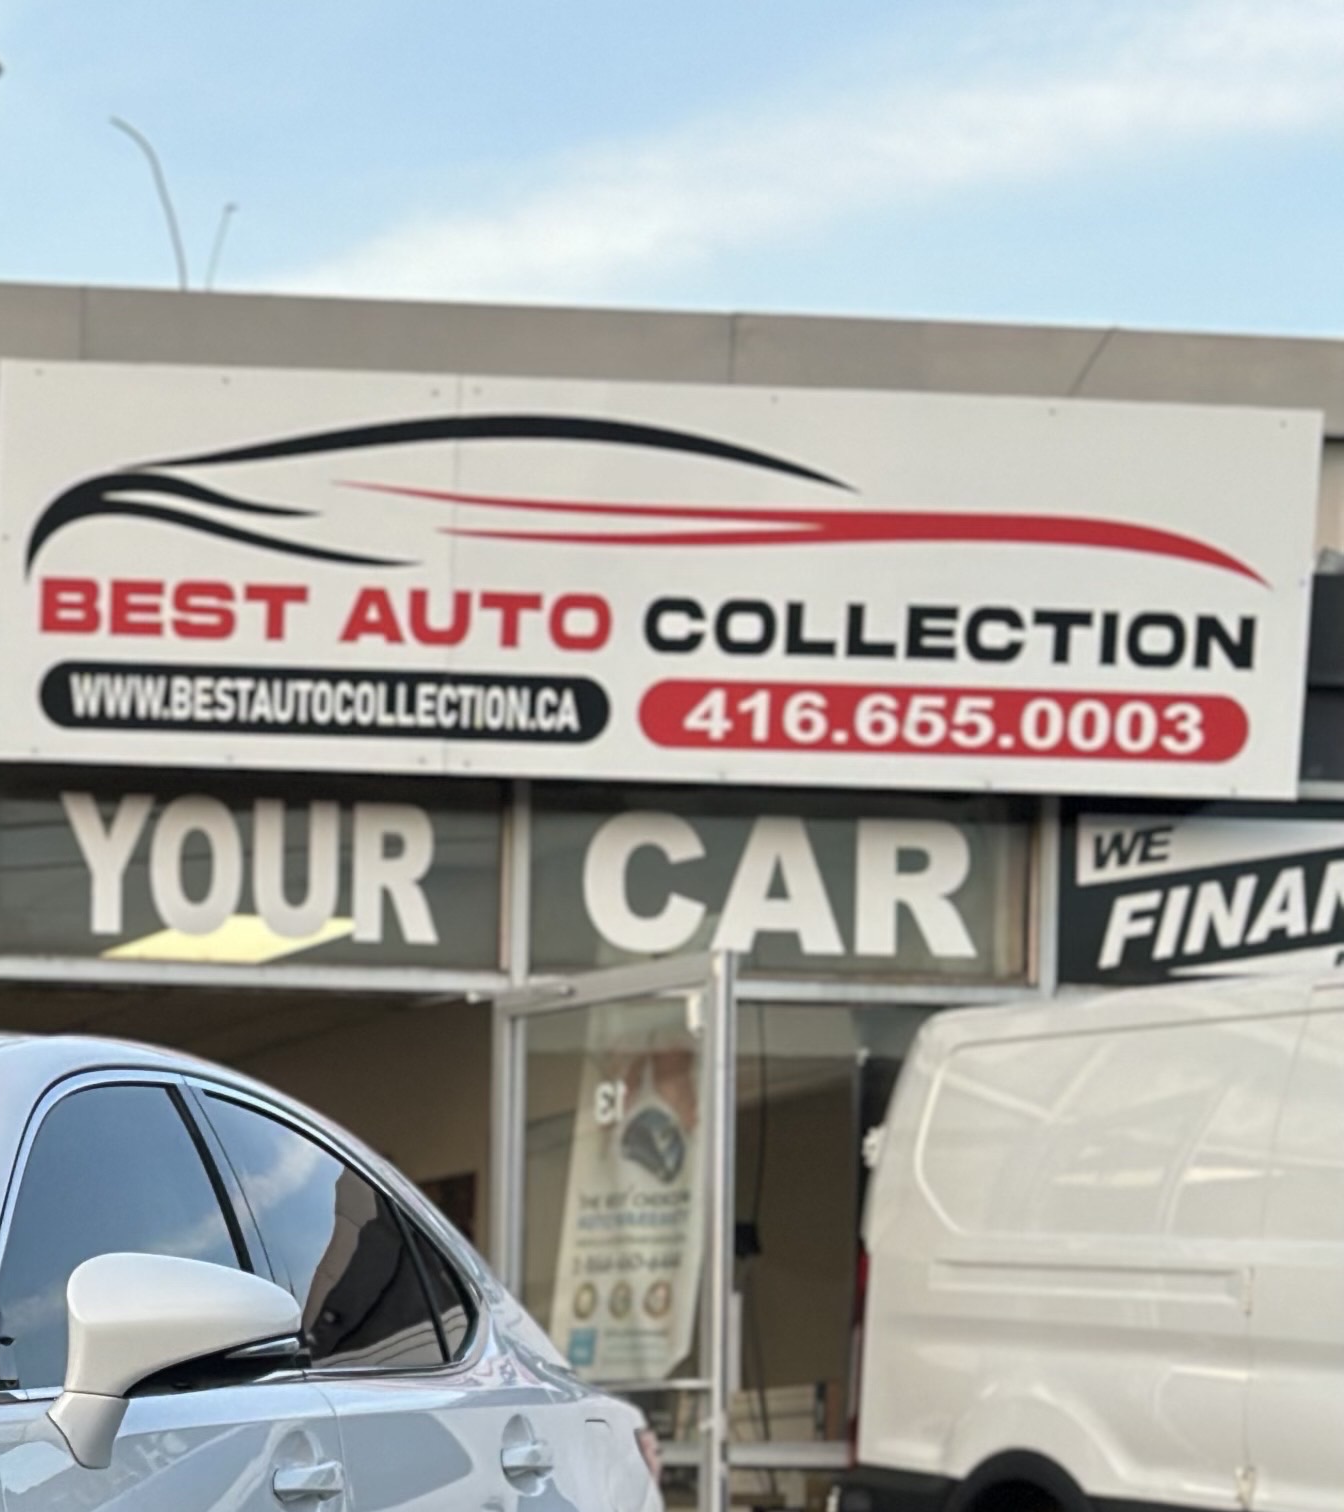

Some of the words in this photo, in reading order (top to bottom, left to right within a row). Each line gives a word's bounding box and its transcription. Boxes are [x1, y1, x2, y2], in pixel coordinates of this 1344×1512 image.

[38, 577, 309, 641] BEST
[338, 586, 613, 652] AUTO
[642, 595, 1258, 671] COLLECTION
[70, 672, 580, 732] WWW.BESTAUTOCOLLECTION.CA
[683, 690, 1205, 755] 416.655.0003
[60, 790, 439, 945] YOUR
[583, 810, 977, 959] CAR
[1093, 825, 1174, 872] WE
